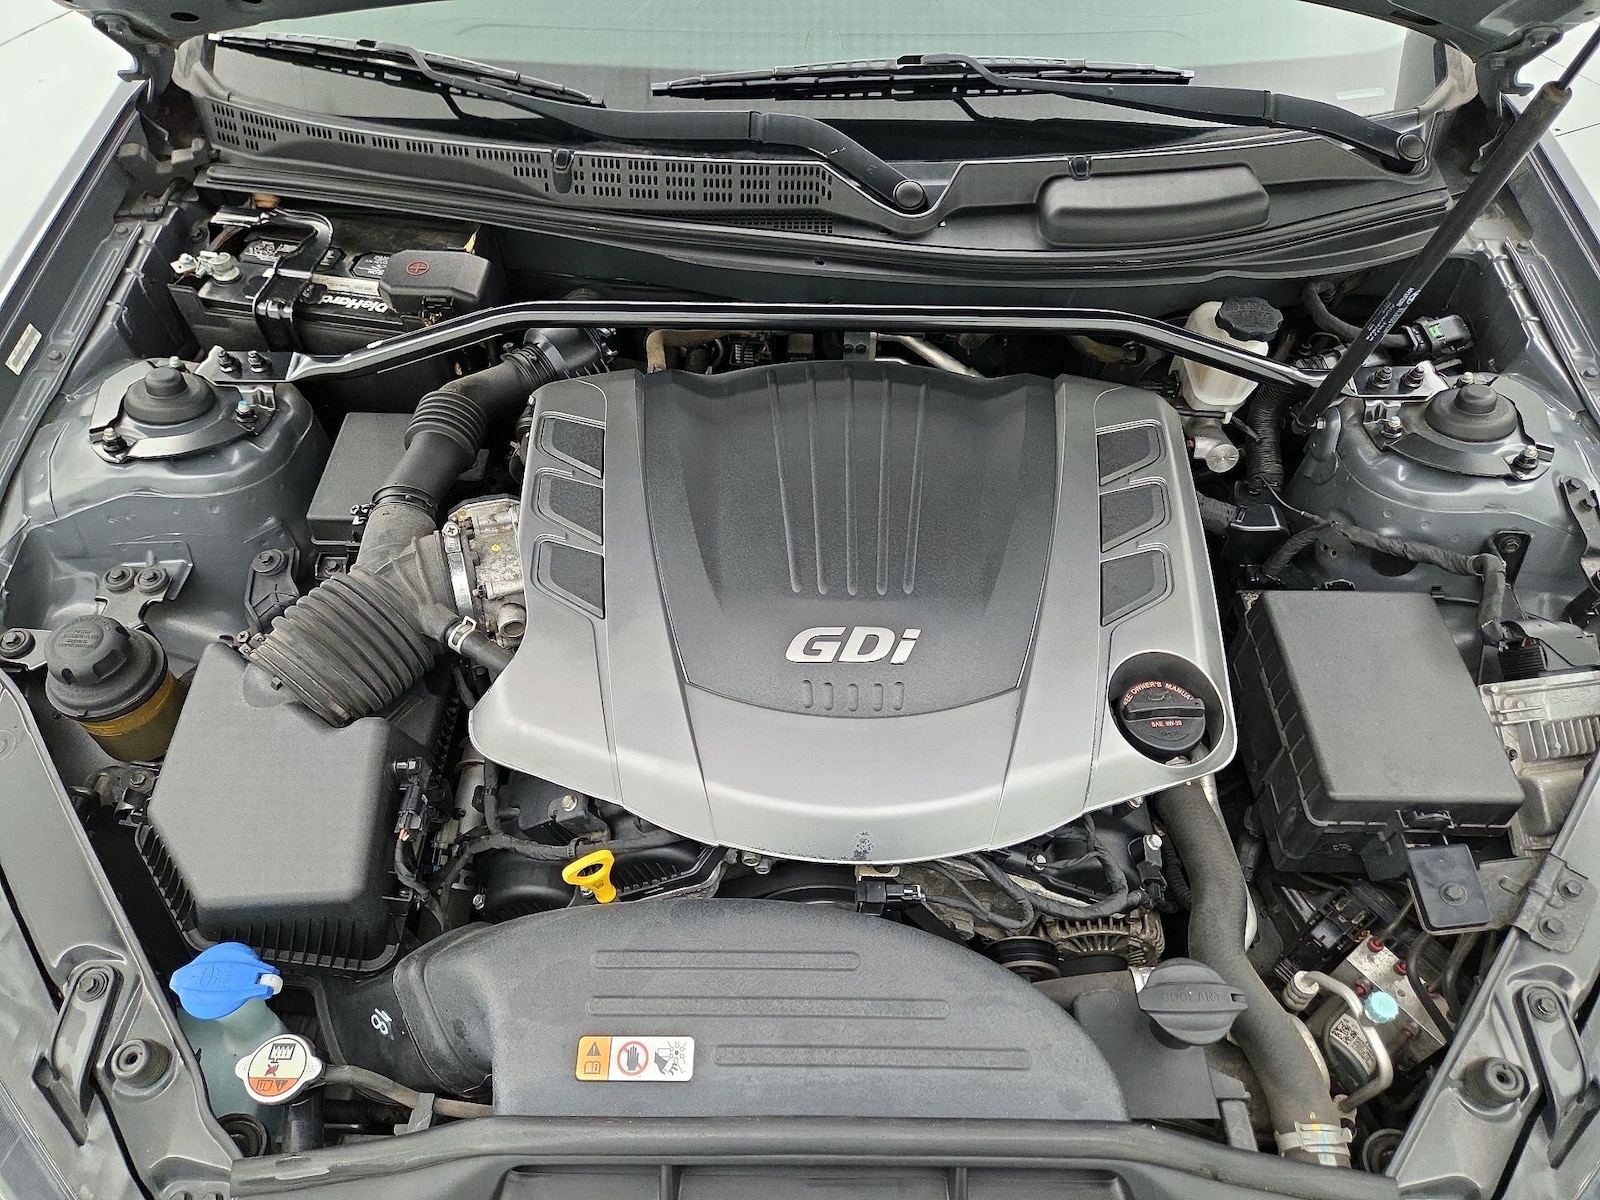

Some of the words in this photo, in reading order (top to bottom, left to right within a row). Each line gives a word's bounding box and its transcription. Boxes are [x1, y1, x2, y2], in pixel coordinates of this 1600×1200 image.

[317, 295, 388, 313] DieHard
[785, 626, 922, 665] GDi
[1130, 681, 1162, 695] OWNER'S
[1150, 720, 1164, 728] SAE
